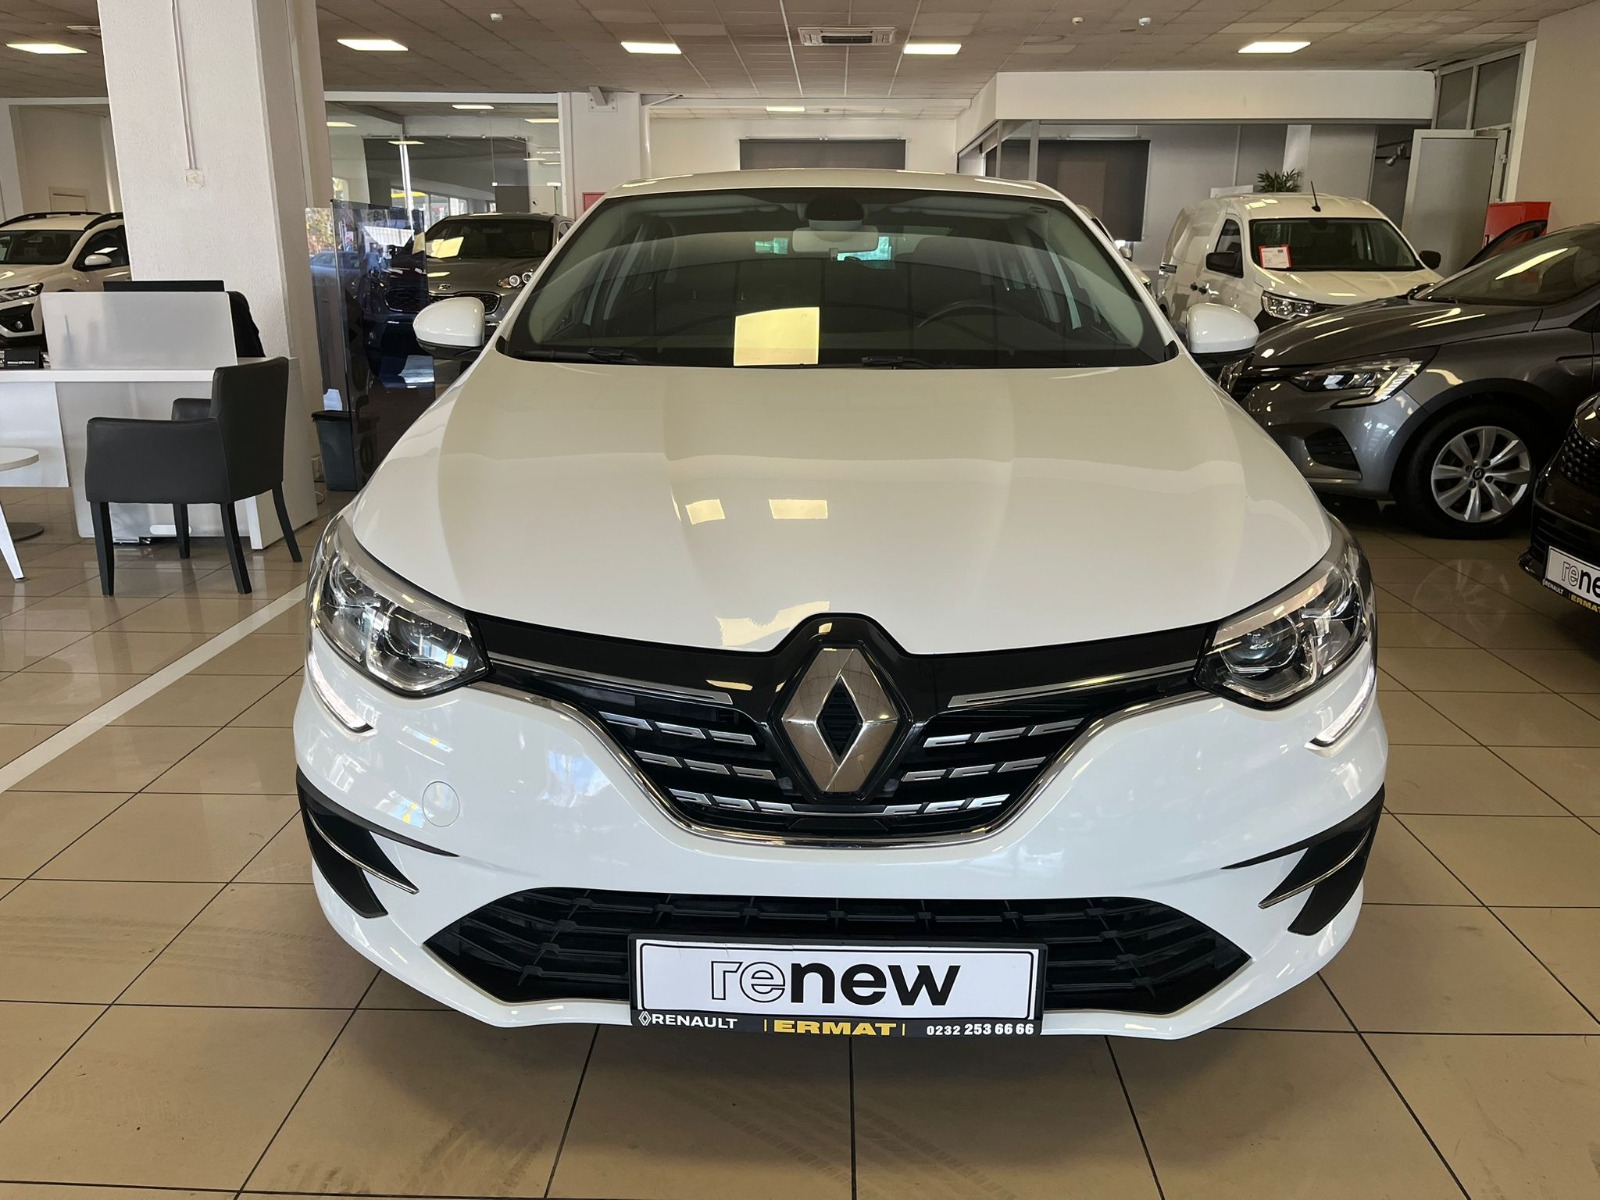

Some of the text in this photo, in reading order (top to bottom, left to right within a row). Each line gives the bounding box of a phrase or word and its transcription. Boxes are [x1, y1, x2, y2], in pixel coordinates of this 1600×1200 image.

[1562, 561, 1600, 599] rene
[711, 960, 961, 1006] renew
[651, 1014, 1034, 1036] RENAULT ERMAT 0232 253 66 66
